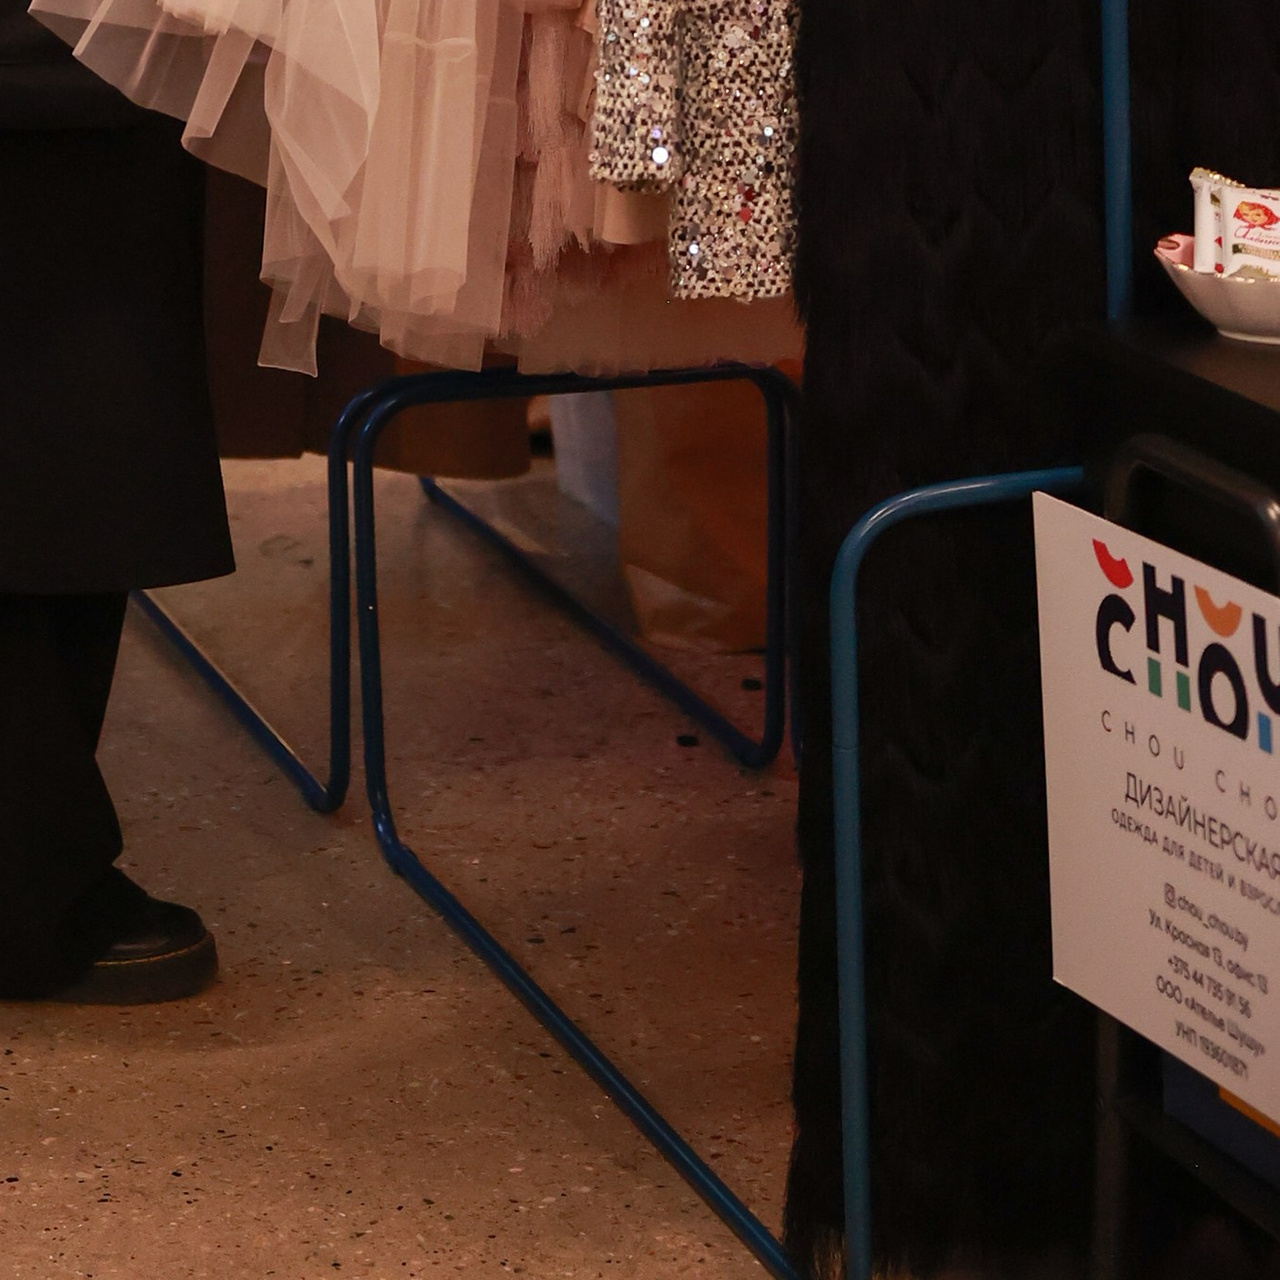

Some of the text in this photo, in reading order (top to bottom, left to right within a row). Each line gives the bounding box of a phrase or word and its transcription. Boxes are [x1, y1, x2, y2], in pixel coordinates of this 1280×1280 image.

[1101, 709, 1185, 770] CHOU
[1111, 808, 1158, 845] ОДЕЖДА
[1162, 836, 1185, 861] ДЛЯ
[1188, 850, 1224, 883] ДЕТЕЙ
[1156, 974, 1183, 1005] ООО
